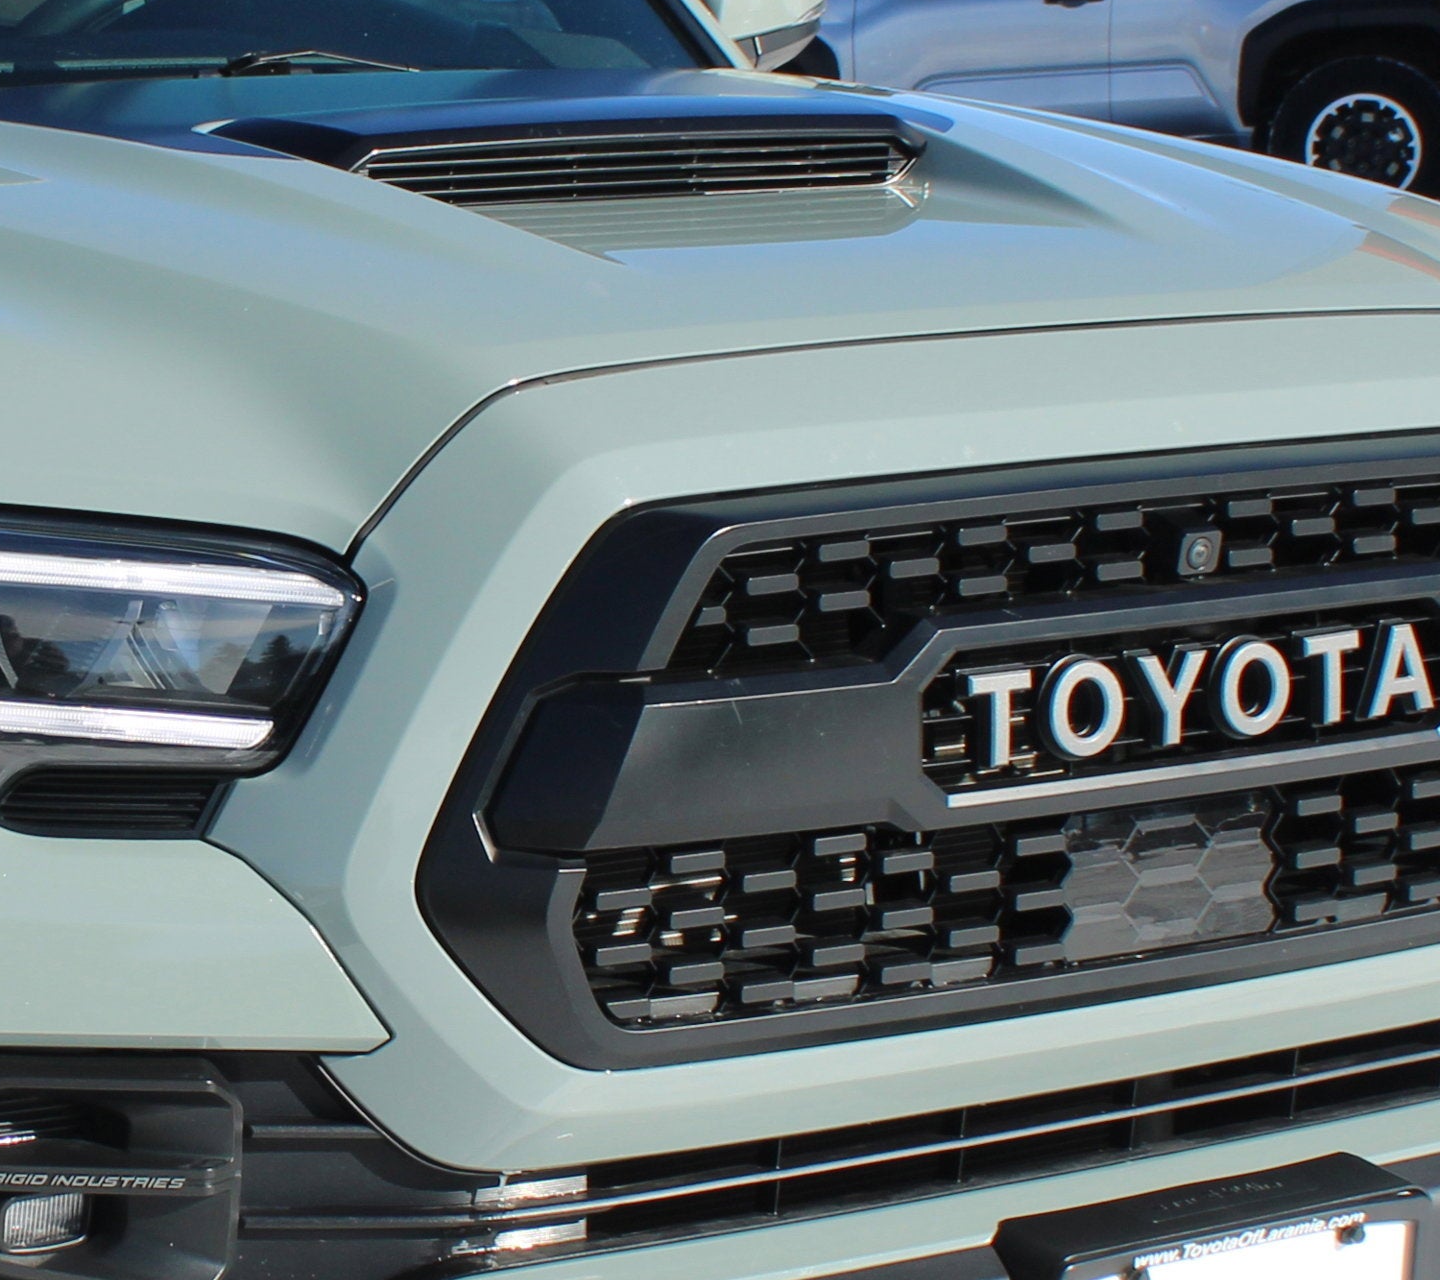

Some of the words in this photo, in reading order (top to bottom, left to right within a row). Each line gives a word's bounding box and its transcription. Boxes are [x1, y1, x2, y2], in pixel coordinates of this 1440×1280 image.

[966, 622, 1436, 768] TOYOTA
[50, 1174, 187, 1190] INDUSTRIES
[1133, 1210, 1368, 1269] www.ToyotaOfLaramie.com
